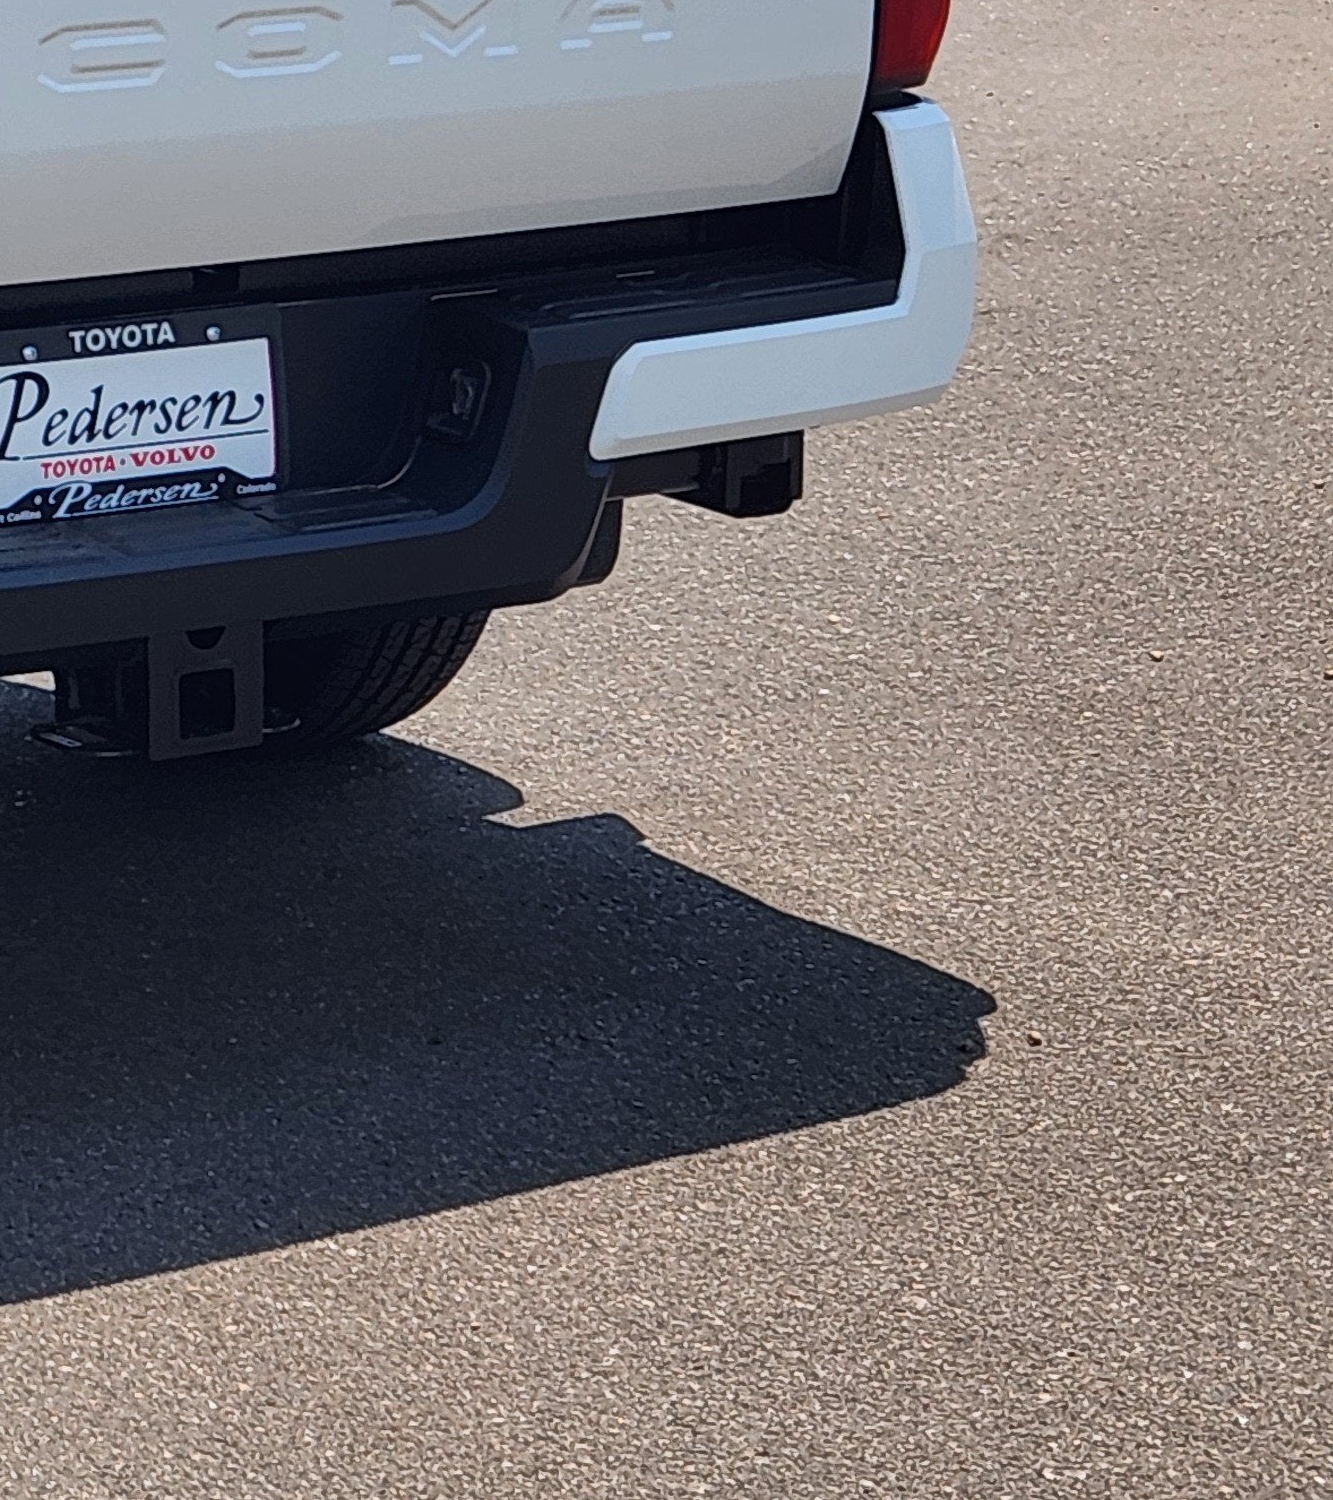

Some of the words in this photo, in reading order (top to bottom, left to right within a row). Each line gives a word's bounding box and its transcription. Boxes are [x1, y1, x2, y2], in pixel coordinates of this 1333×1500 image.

[69, 321, 176, 353] TOYOTA
[40, 455, 116, 479] TOYOTA
[130, 444, 216, 468] VOLVO
[48, 480, 219, 519] Pedersen
